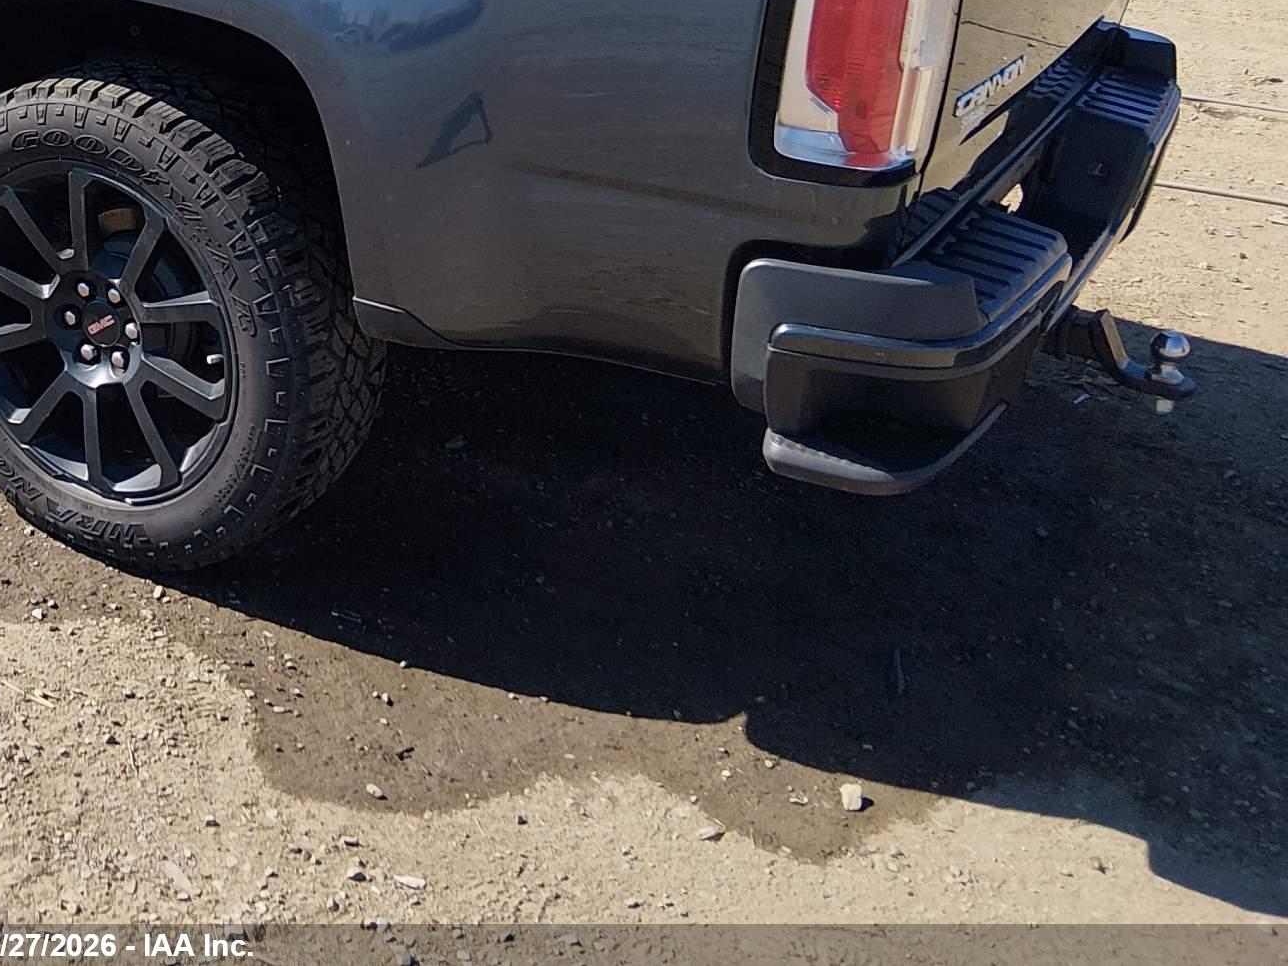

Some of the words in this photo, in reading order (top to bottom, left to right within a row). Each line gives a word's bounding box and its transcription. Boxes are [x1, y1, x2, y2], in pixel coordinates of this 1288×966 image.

[953, 54, 1027, 118] CANYON
[10, 128, 258, 338] GOODYEAR
[87, 314, 116, 335] GMC
